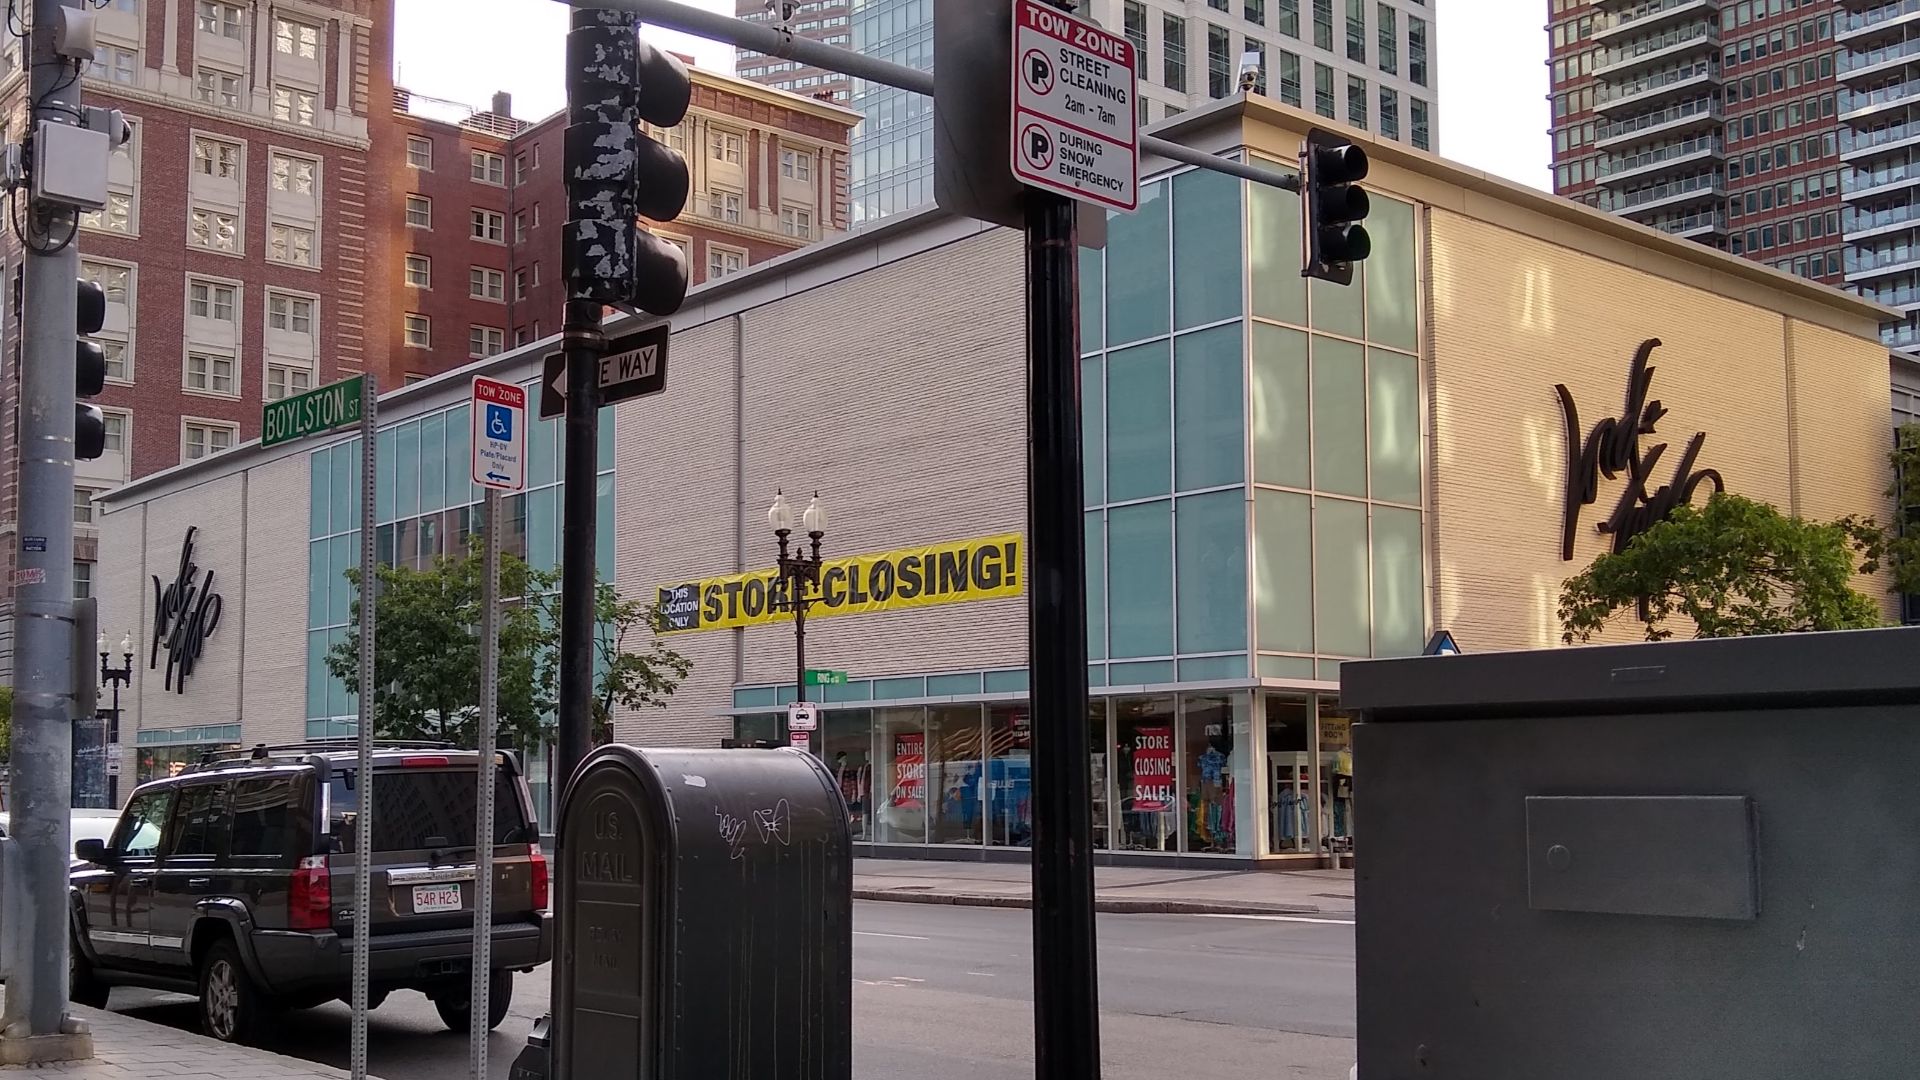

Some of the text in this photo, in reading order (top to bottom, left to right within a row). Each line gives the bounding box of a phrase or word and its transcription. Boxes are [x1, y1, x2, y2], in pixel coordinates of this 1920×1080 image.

[1026, 5, 1125, 62] TOW ZONE
[1060, 48, 1110, 79] STREET
[1060, 68, 1126, 104] CLEANING
[1065, 94, 1085, 115] 2am
[1098, 105, 1116, 126] 7am
[1060, 132, 1103, 156] DURING
[1060, 147, 1095, 167] SNOW
[1060, 162, 1124, 192] EMERGENCY
[620, 348, 654, 380] WAY
[478, 384, 522, 404] TOW ZONE
[266, 387, 359, 441] BOYLSTON ST
[492, 461, 504, 472] Only
[822, 542, 1017, 608] CLOSING!
[670, 587, 689, 600] THIS
[660, 600, 699, 615] LOCATION
[668, 616, 689, 628] ONLY
[896, 742, 923, 756] ENTIRE
[1135, 735, 1169, 750] STORE
[896, 763, 924, 779] STORE
[1134, 757, 1171, 776] CLOSING
[896, 785, 925, 799] ON SALE!
[1135, 784, 1170, 801] SALE!
[594, 811, 623, 840] U.S.
[582, 851, 633, 882] MAIL
[416, 890, 459, 907] 54R H23
